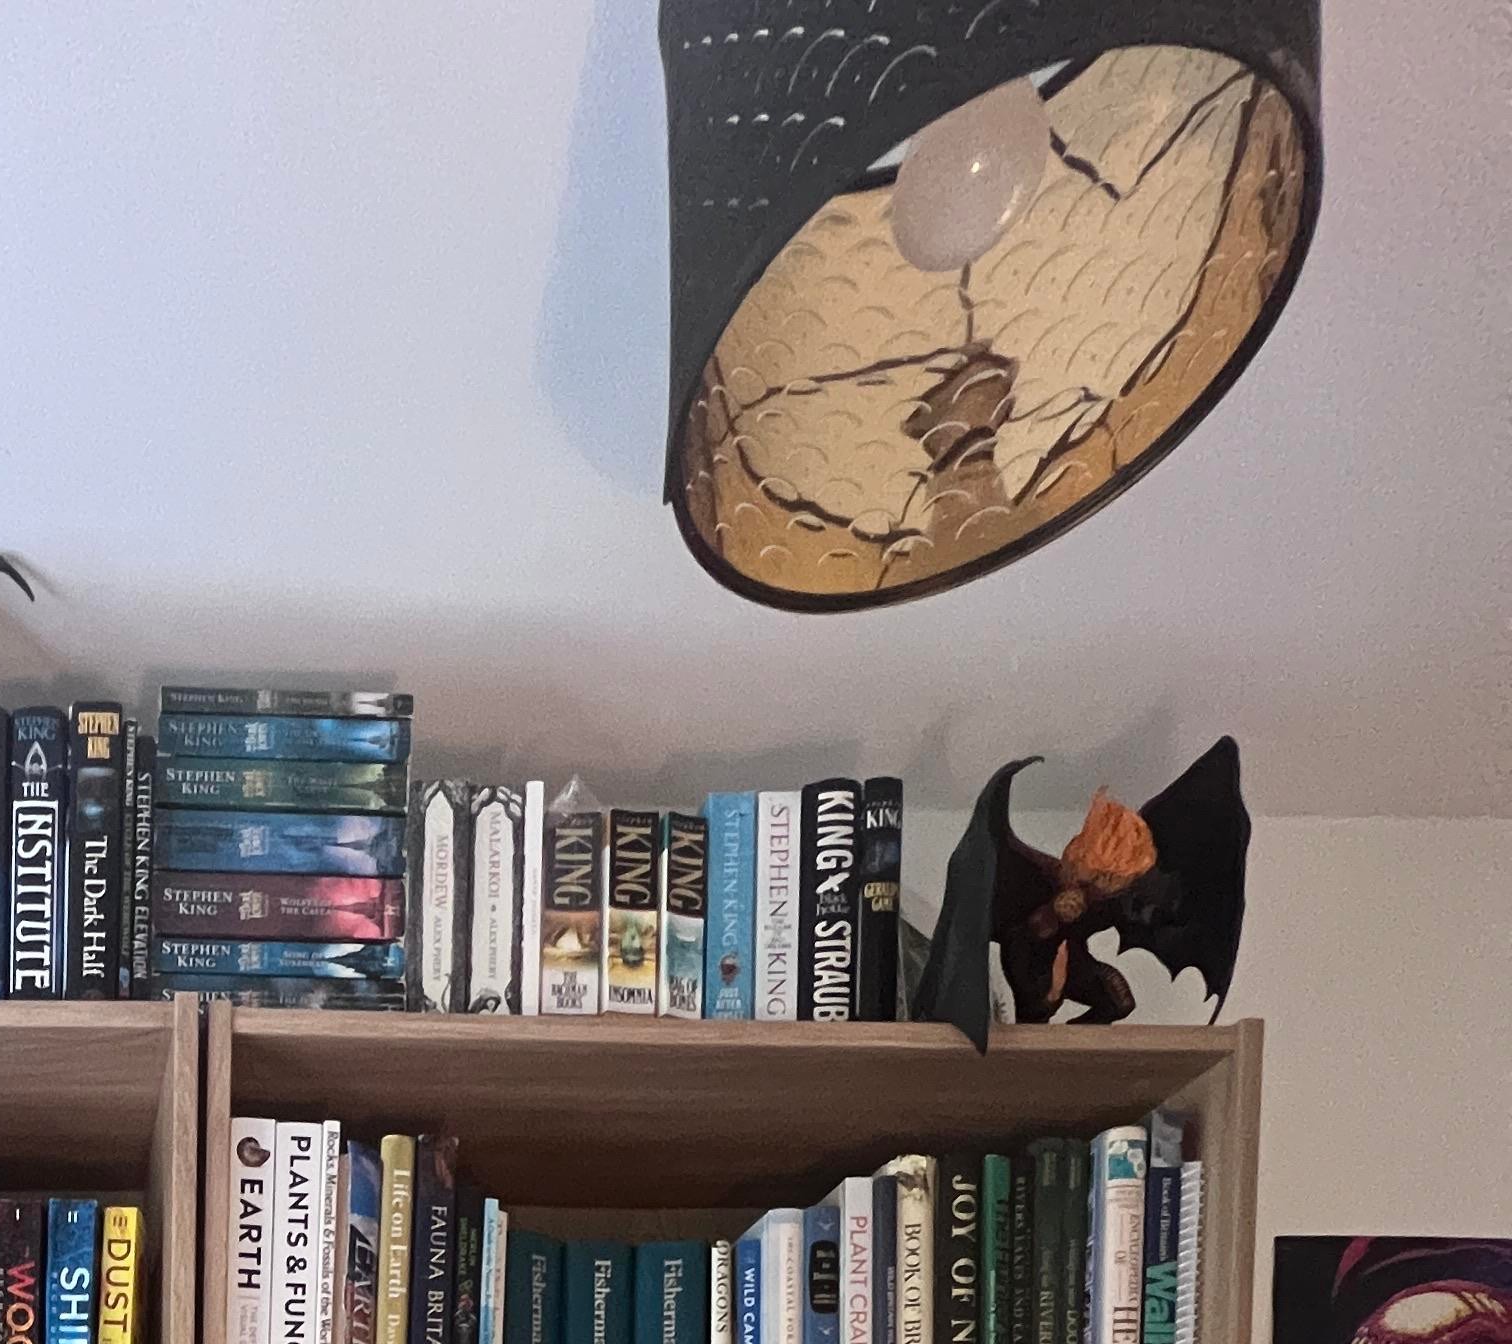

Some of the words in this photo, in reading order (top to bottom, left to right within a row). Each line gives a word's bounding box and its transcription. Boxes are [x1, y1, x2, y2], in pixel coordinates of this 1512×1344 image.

[78, 712, 118, 734] STEPHEN
[87, 737, 109, 758] KING
[22, 782, 48, 797] THE
[85, 836, 107, 874] The
[770, 805, 789, 918] STEPHEN
[816, 792, 854, 870] KING
[14, 801, 59, 993] INSTITUTE
[163, 888, 233, 902] STEPHEN
[554, 828, 592, 905] KING
[83, 879, 107, 928] Dark
[178, 903, 218, 915] KING
[82, 932, 106, 977] Half
[766, 953, 787, 1015] KING
[813, 920, 851, 1022] STRAUB
[287, 1135, 311, 1248] PLANTS
[951, 1175, 977, 1245] JOY
[238, 1178, 263, 1290] EARTH
[286, 1256, 307, 1273] &
[429, 1206, 448, 1279] FAUNA
[850, 1216, 868, 1285] PLANT
[104, 1239, 131, 1332] DUST
[743, 1268, 756, 1310] WILD
[951, 1262, 976, 1310] OF
